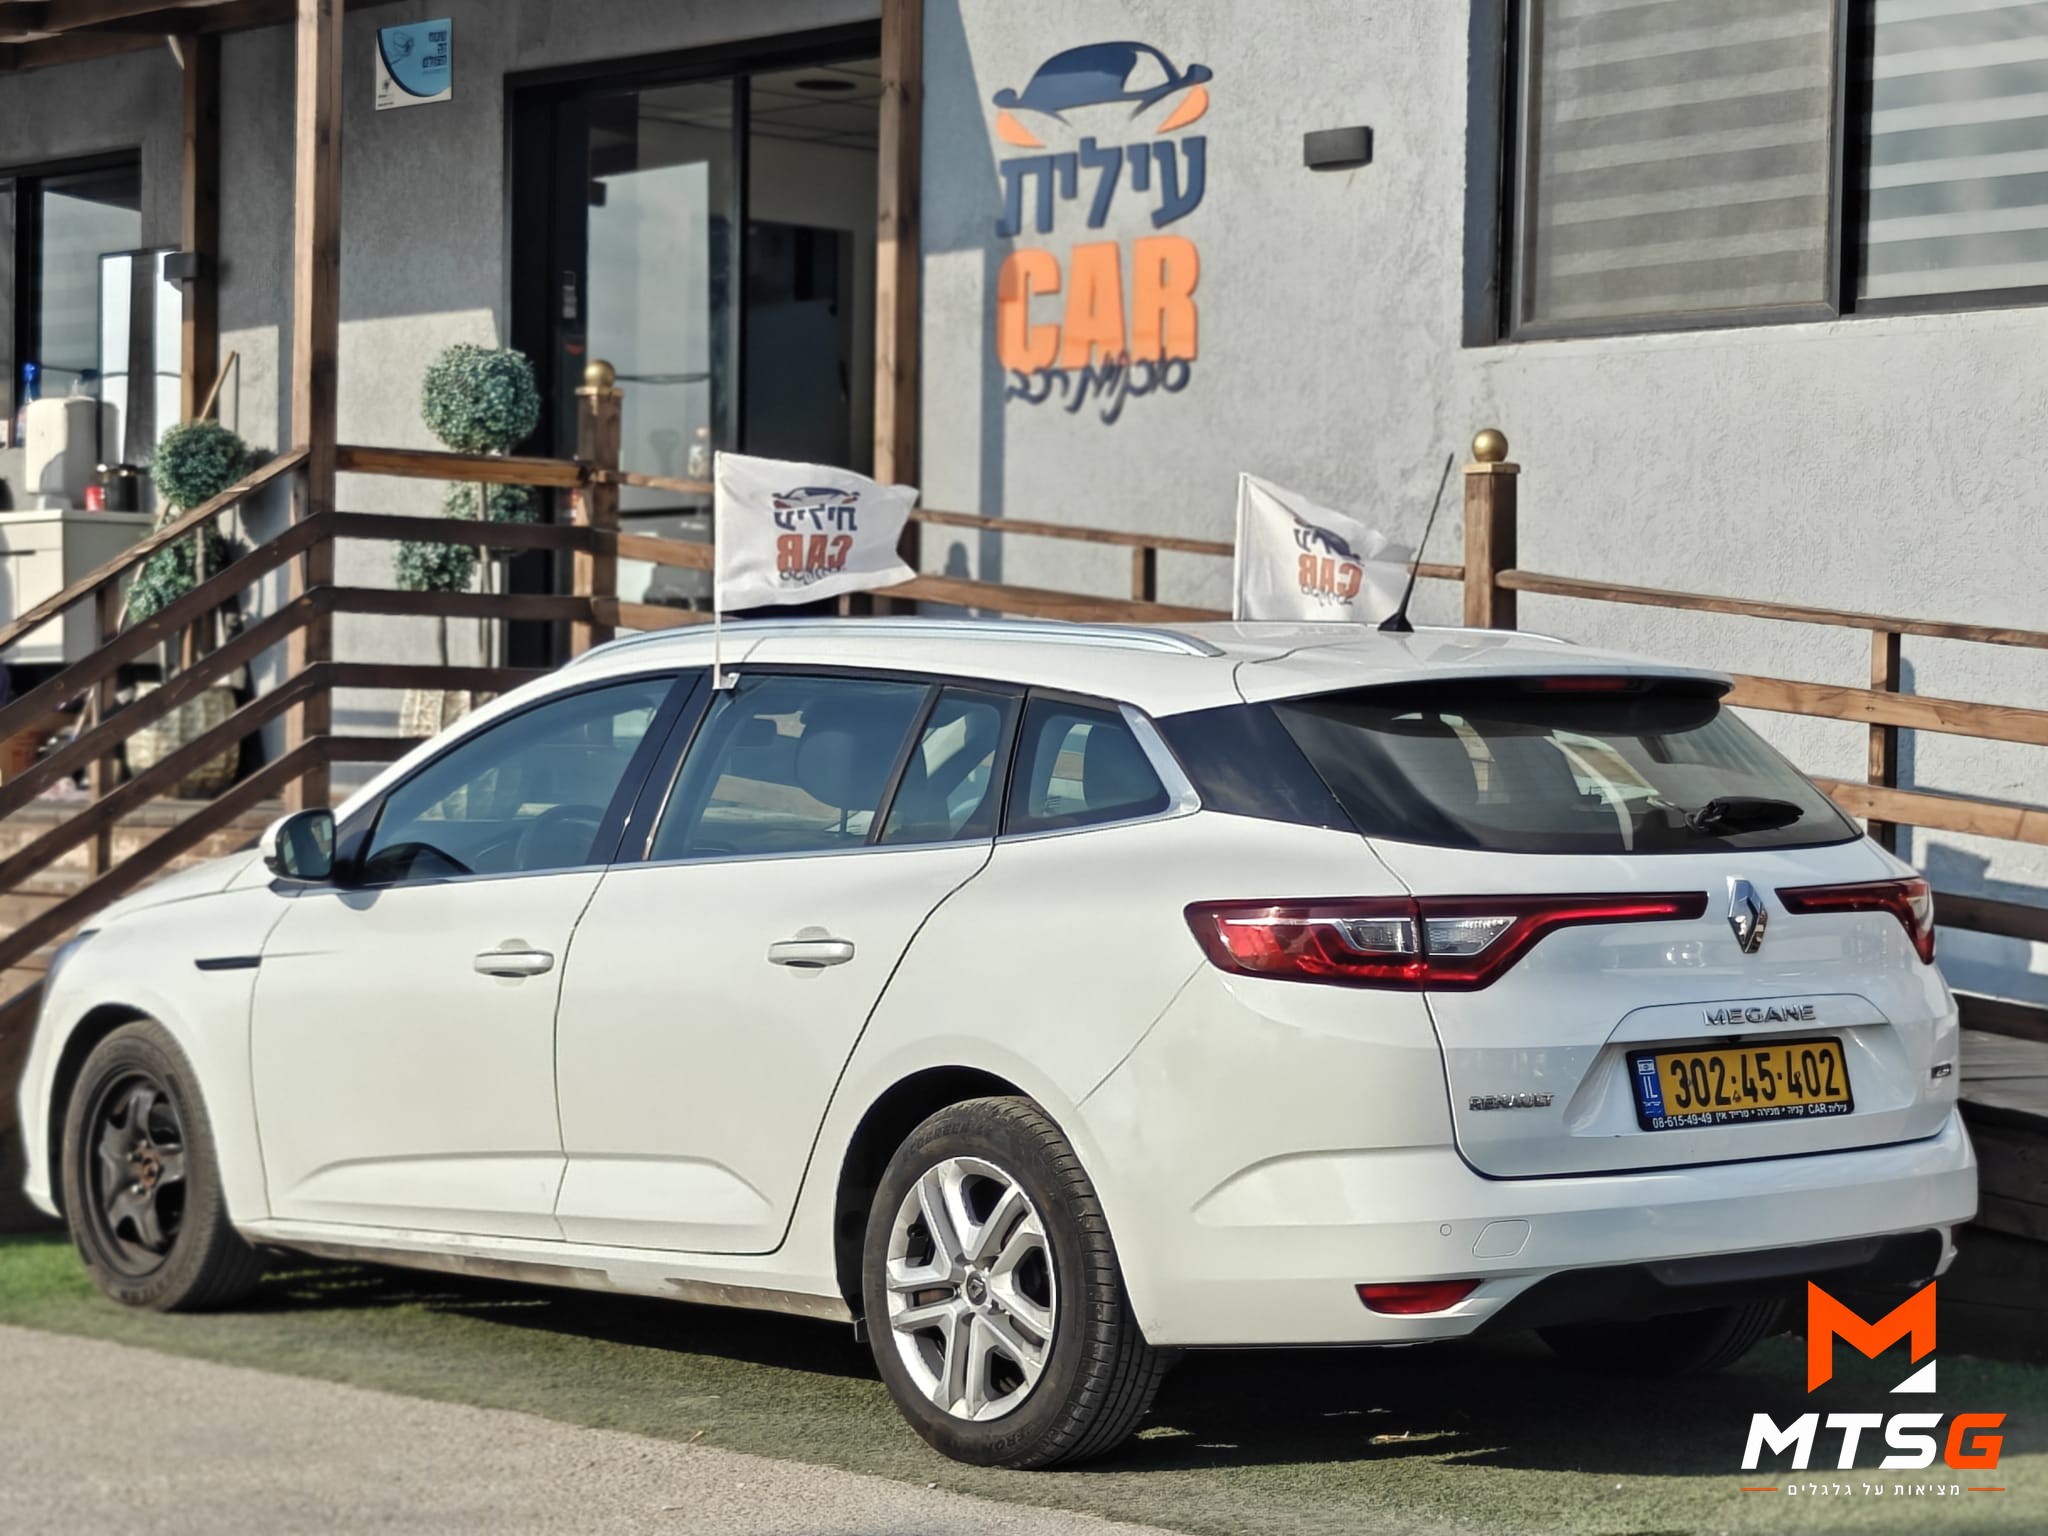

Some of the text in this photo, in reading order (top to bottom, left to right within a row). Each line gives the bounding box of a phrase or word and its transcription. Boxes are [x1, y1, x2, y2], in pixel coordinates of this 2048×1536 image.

[996, 136, 1206, 238] עילית
[996, 235, 1199, 374] CAR
[1702, 1005, 1817, 1026] MEGANE
[1643, 1075, 1659, 1099] IL
[1468, 1093, 1555, 1111] RENAULT
[1787, 1104, 1804, 1116] קניה
[1808, 1103, 1828, 1114] CAR
[1652, 1112, 1712, 1129] 08-615-49-49
[1757, 1106, 1781, 1117] מכירה
